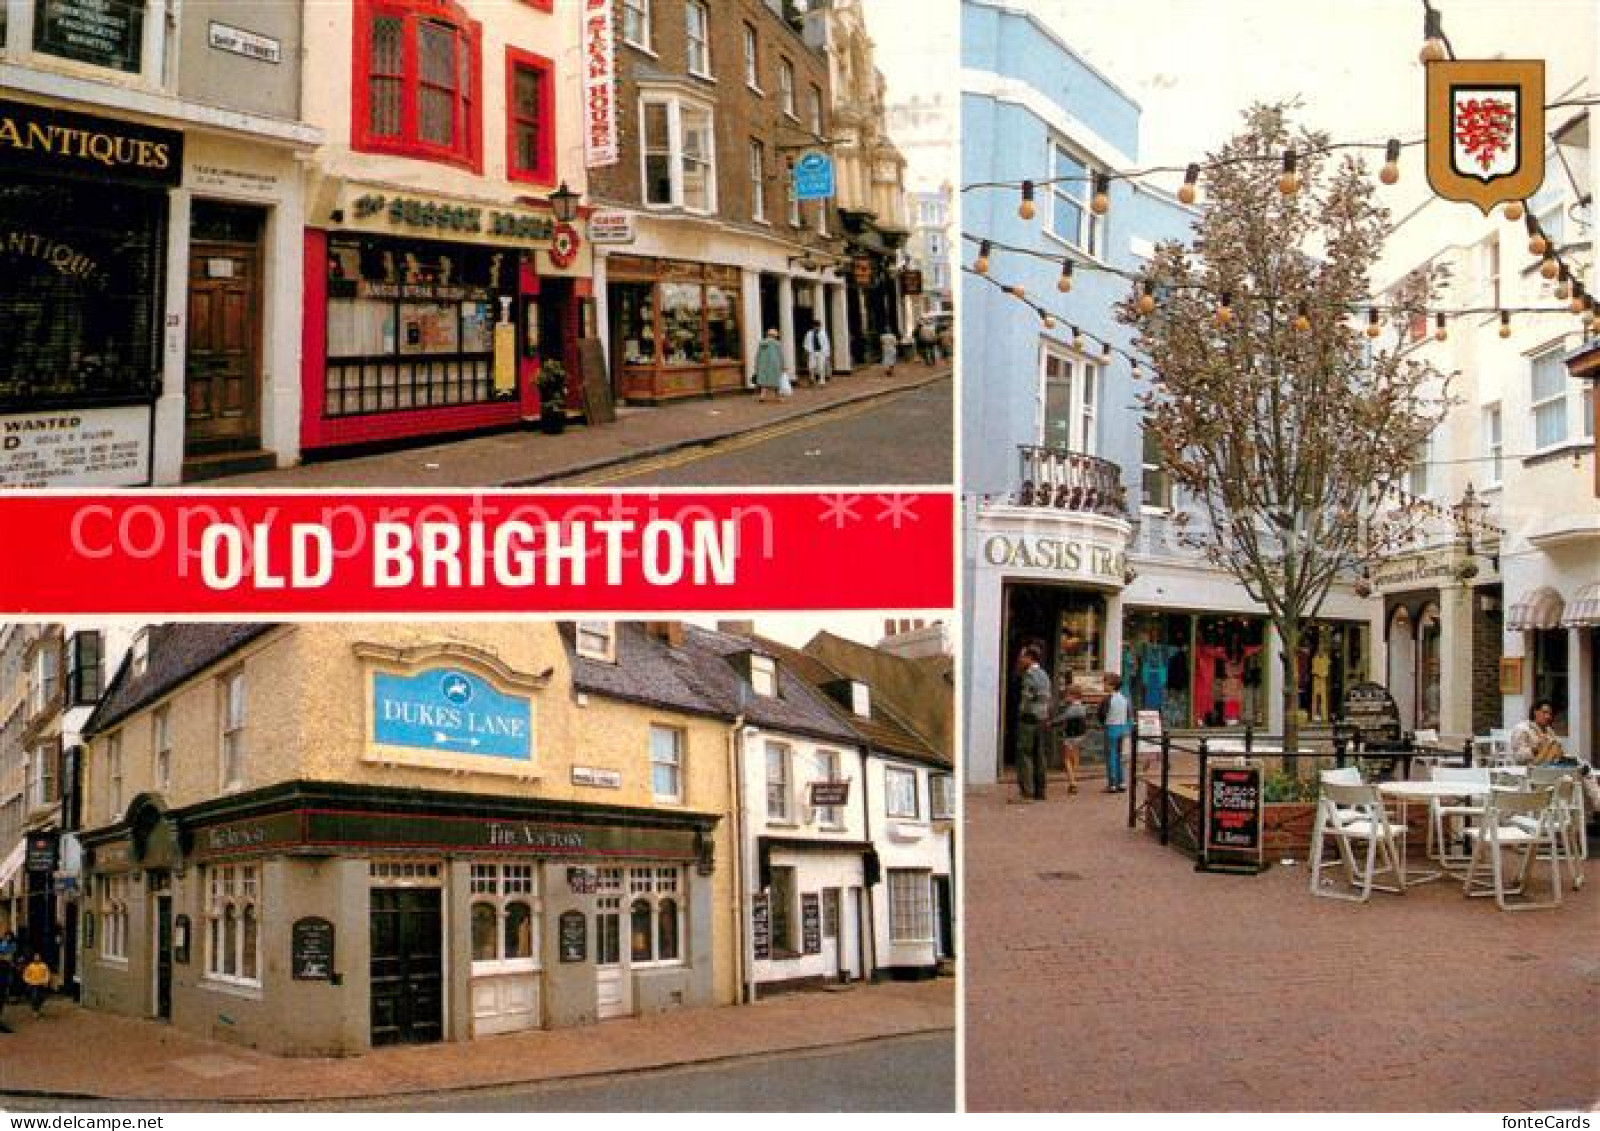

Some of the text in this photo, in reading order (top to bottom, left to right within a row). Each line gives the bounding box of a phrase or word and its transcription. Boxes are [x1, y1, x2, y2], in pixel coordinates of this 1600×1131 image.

[0, 118, 169, 169] ANTIQUES
[4, 417, 82, 432] WANTED
[985, 535, 1082, 571] OASIS
[468, 712, 525, 737] LANE
